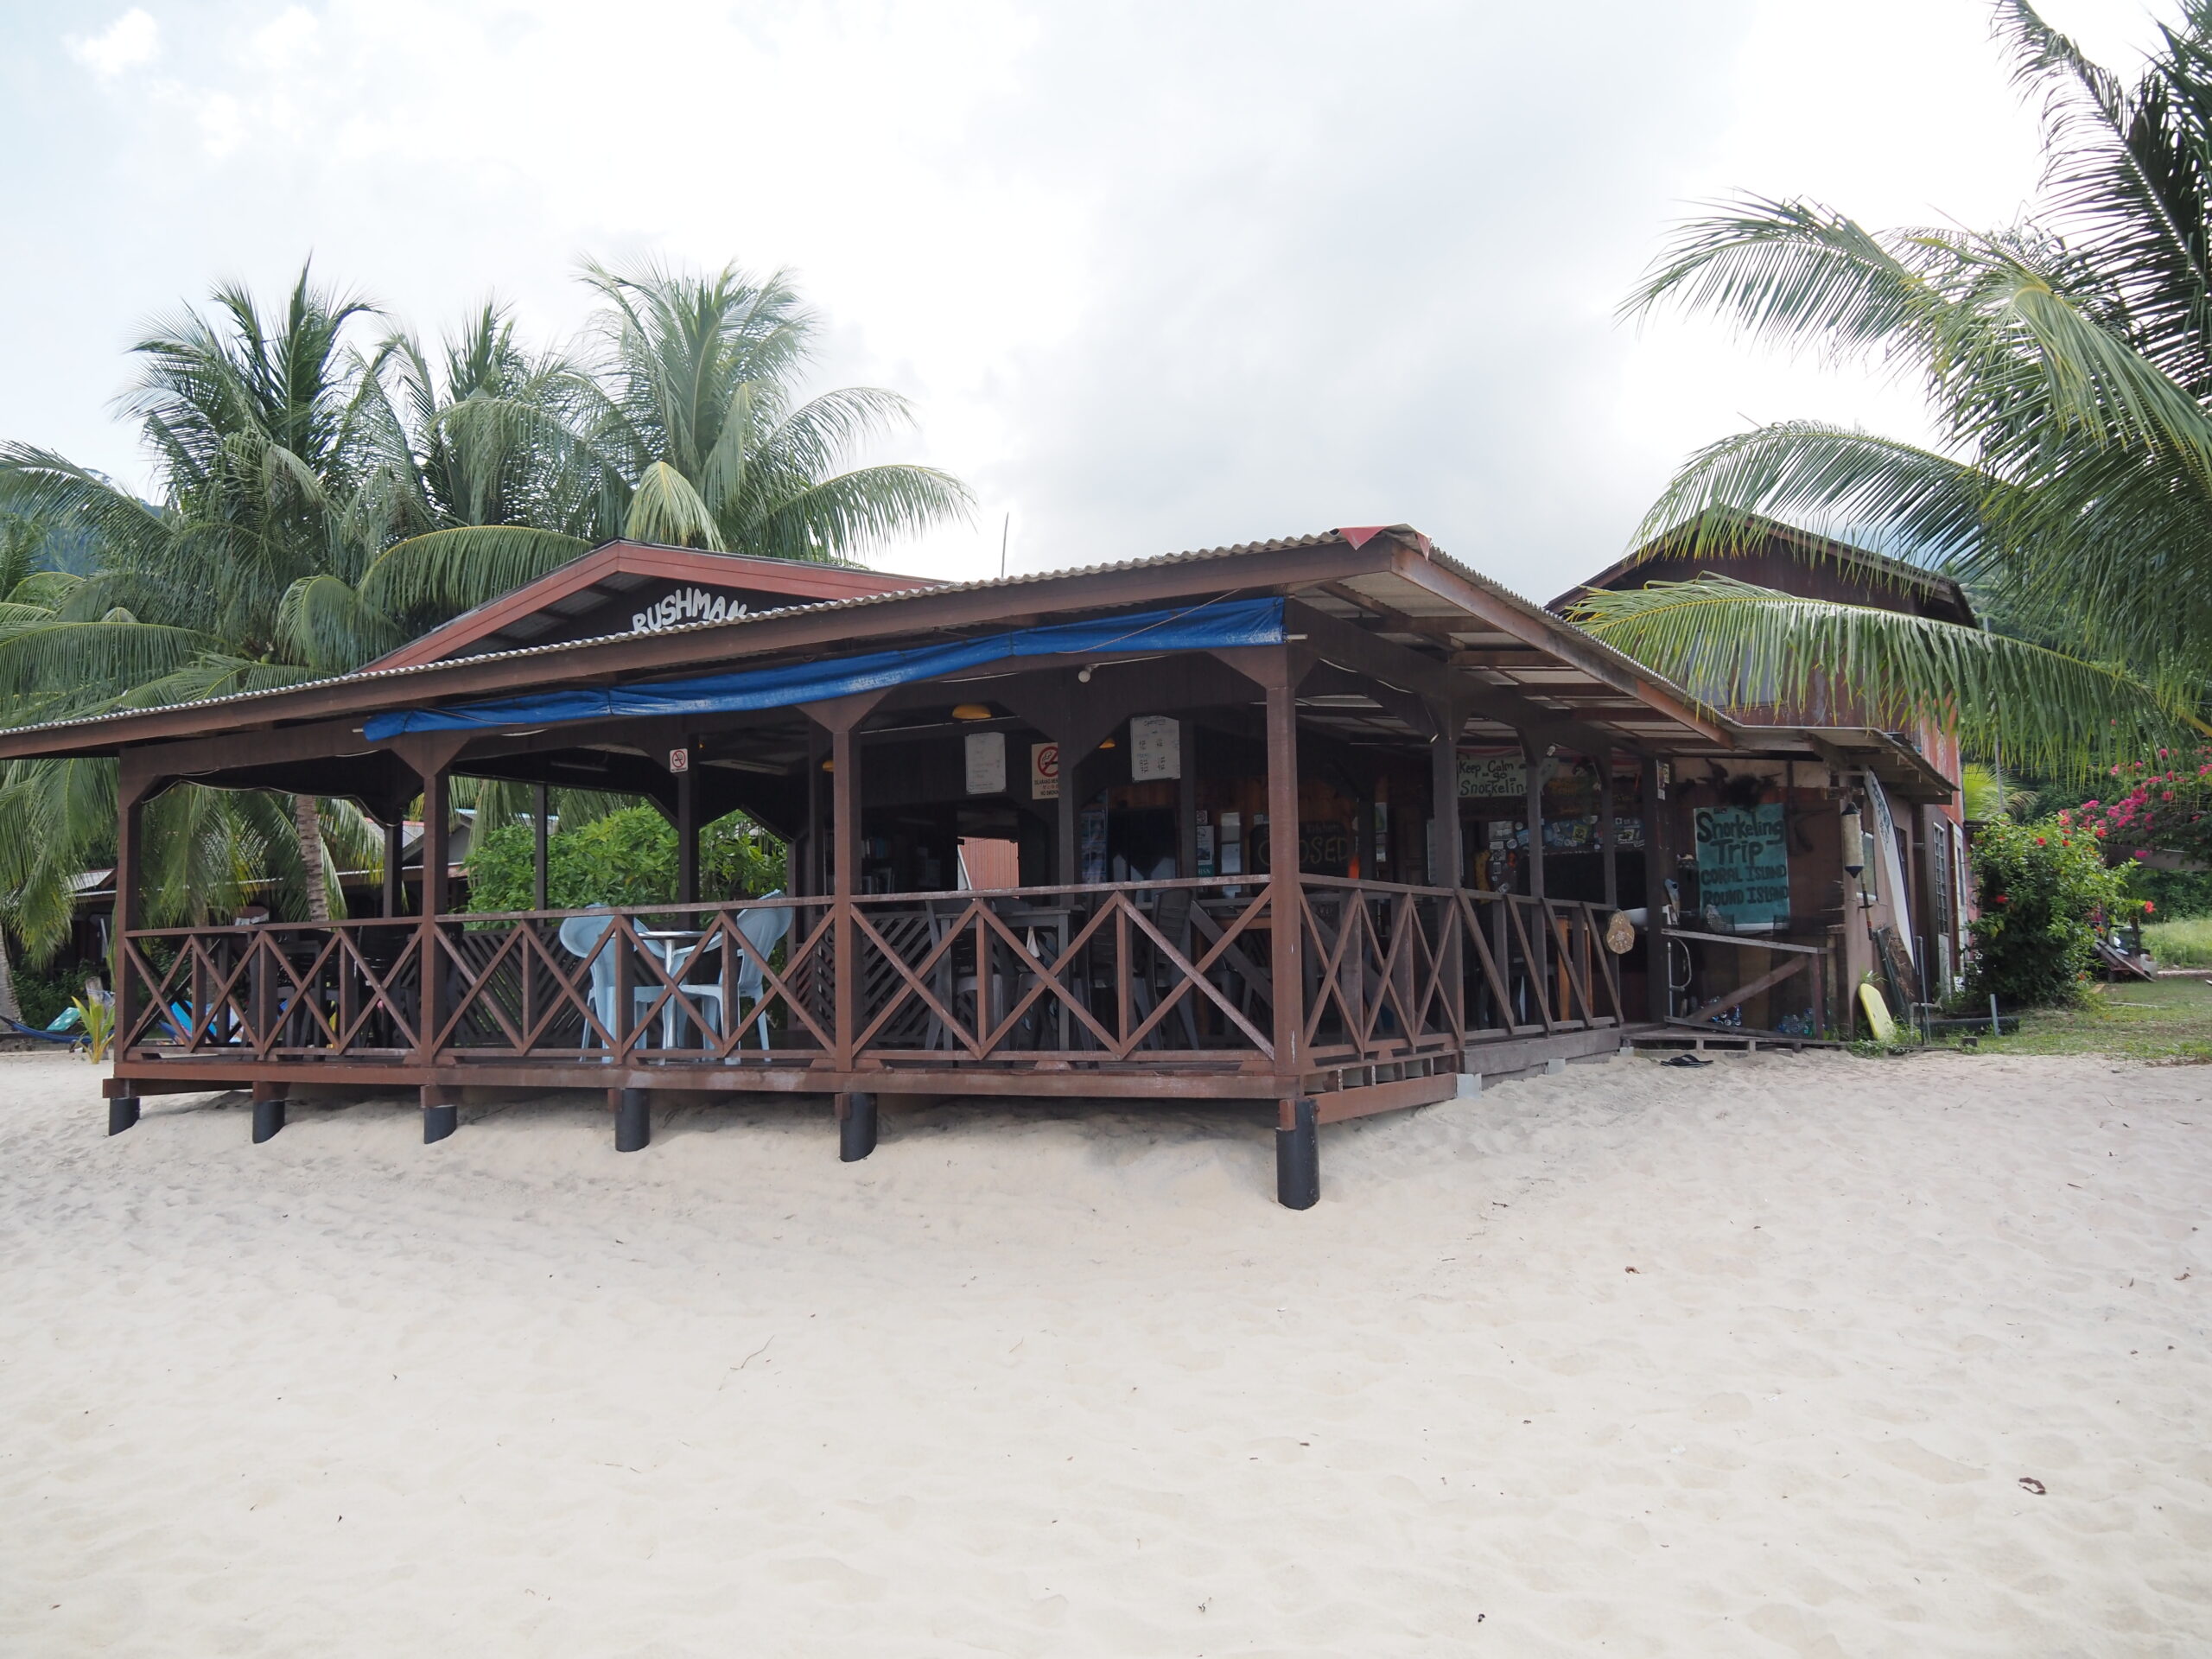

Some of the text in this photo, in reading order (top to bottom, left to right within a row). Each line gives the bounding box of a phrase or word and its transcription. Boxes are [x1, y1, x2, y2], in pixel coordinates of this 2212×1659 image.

[1459, 760, 1514, 778] Keep Calm
[1493, 772, 1507, 782] go
[1460, 779, 1527, 796] Snorkelin
[1696, 811, 1785, 844] Snorkeling
[1710, 838, 1764, 865] Trip
[1700, 864, 1786, 885] CORAL ISLAND
[1702, 886, 1789, 907] ROUND ISLAND
